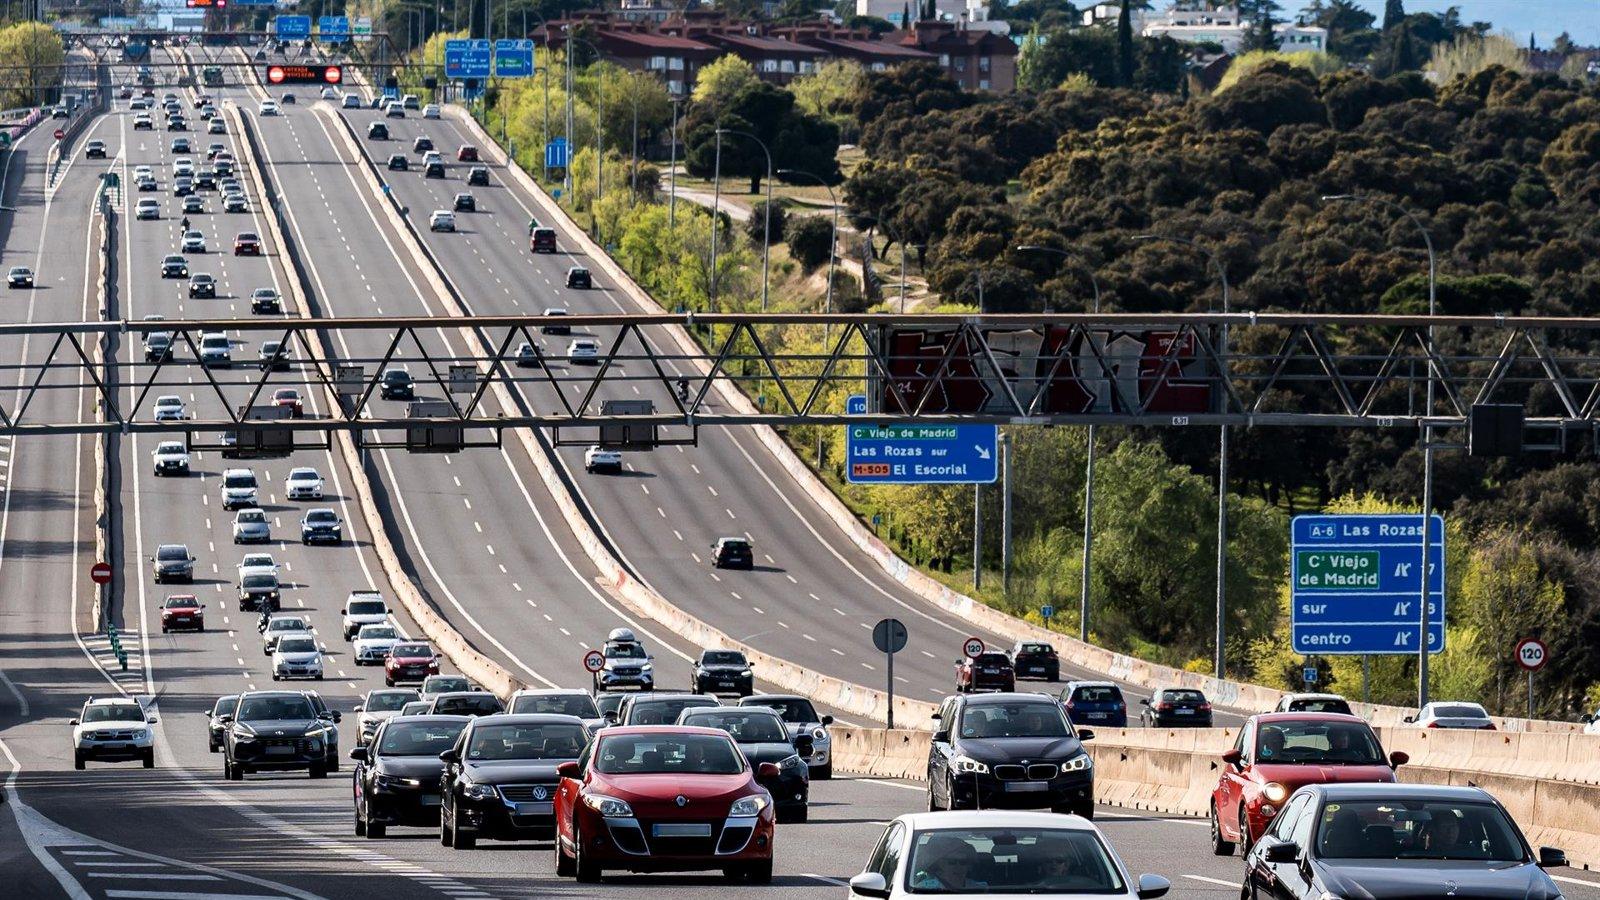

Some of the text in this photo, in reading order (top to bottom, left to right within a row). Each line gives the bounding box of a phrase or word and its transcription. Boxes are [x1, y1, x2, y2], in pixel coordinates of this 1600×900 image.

[869, 428, 896, 438] Viejo
[901, 428, 914, 438] de
[920, 428, 956, 438] Madrid
[854, 446, 948, 456] Las Rozas sur
[854, 464, 967, 475] M-505 El Escorial
[1312, 524, 1424, 536] A-6 Las Rozas
[1330, 555, 1369, 570] Viejo
[1300, 573, 1377, 585] de Madrid
[1302, 604, 1328, 614] sur
[1301, 633, 1352, 645] centro
[968, 644, 981, 652] 120
[1522, 648, 1542, 660] 120
[588, 658, 603, 666] 120
